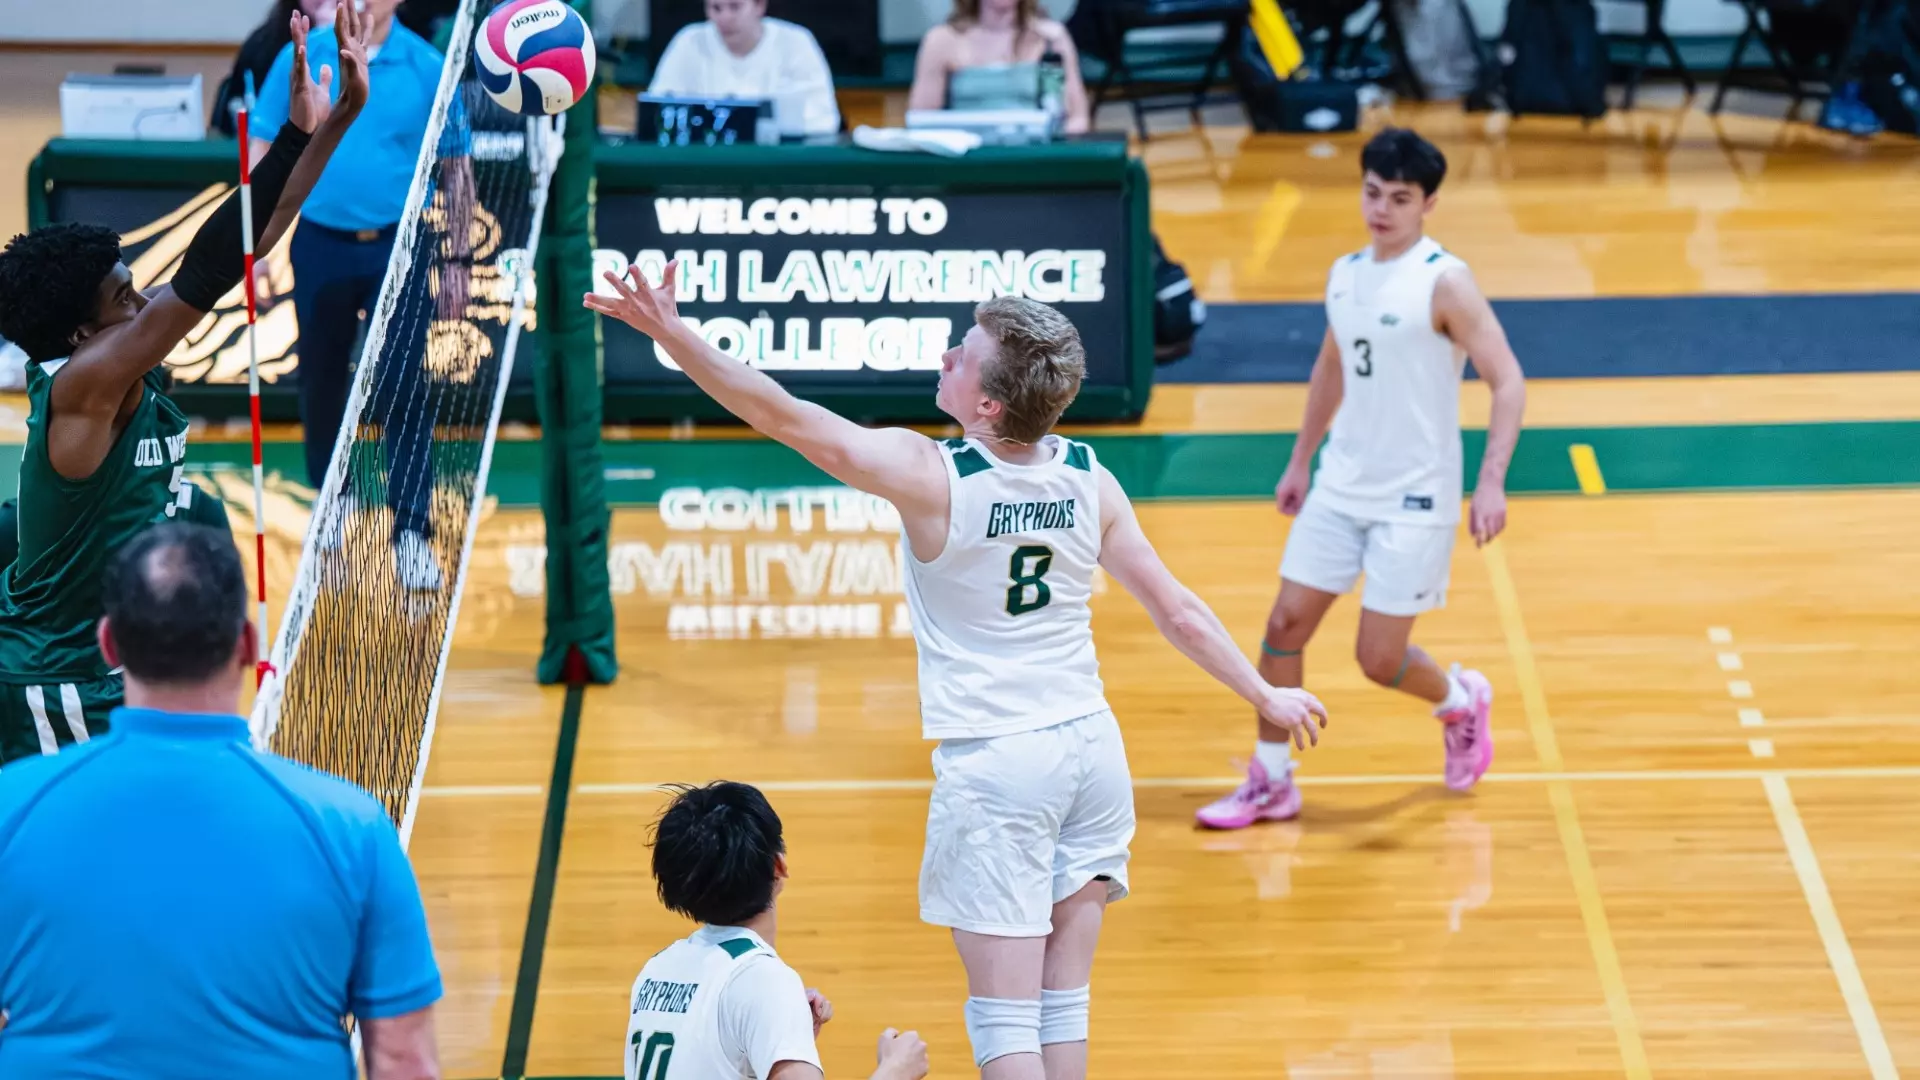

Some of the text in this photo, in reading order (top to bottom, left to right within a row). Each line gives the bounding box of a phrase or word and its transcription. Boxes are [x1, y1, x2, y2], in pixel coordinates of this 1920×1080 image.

[511, 9, 560, 29] molten
[655, 198, 948, 235] WELCOME TO
[738, 249, 1106, 303] LAWRENCE
[1353, 338, 1372, 378] 3
[134, 437, 163, 467] OLD
[986, 498, 1076, 539] GRYPHONS
[1005, 544, 1054, 617] 8
[632, 978, 699, 1015] GRYPHONS
[631, 1028, 676, 1080] 10
